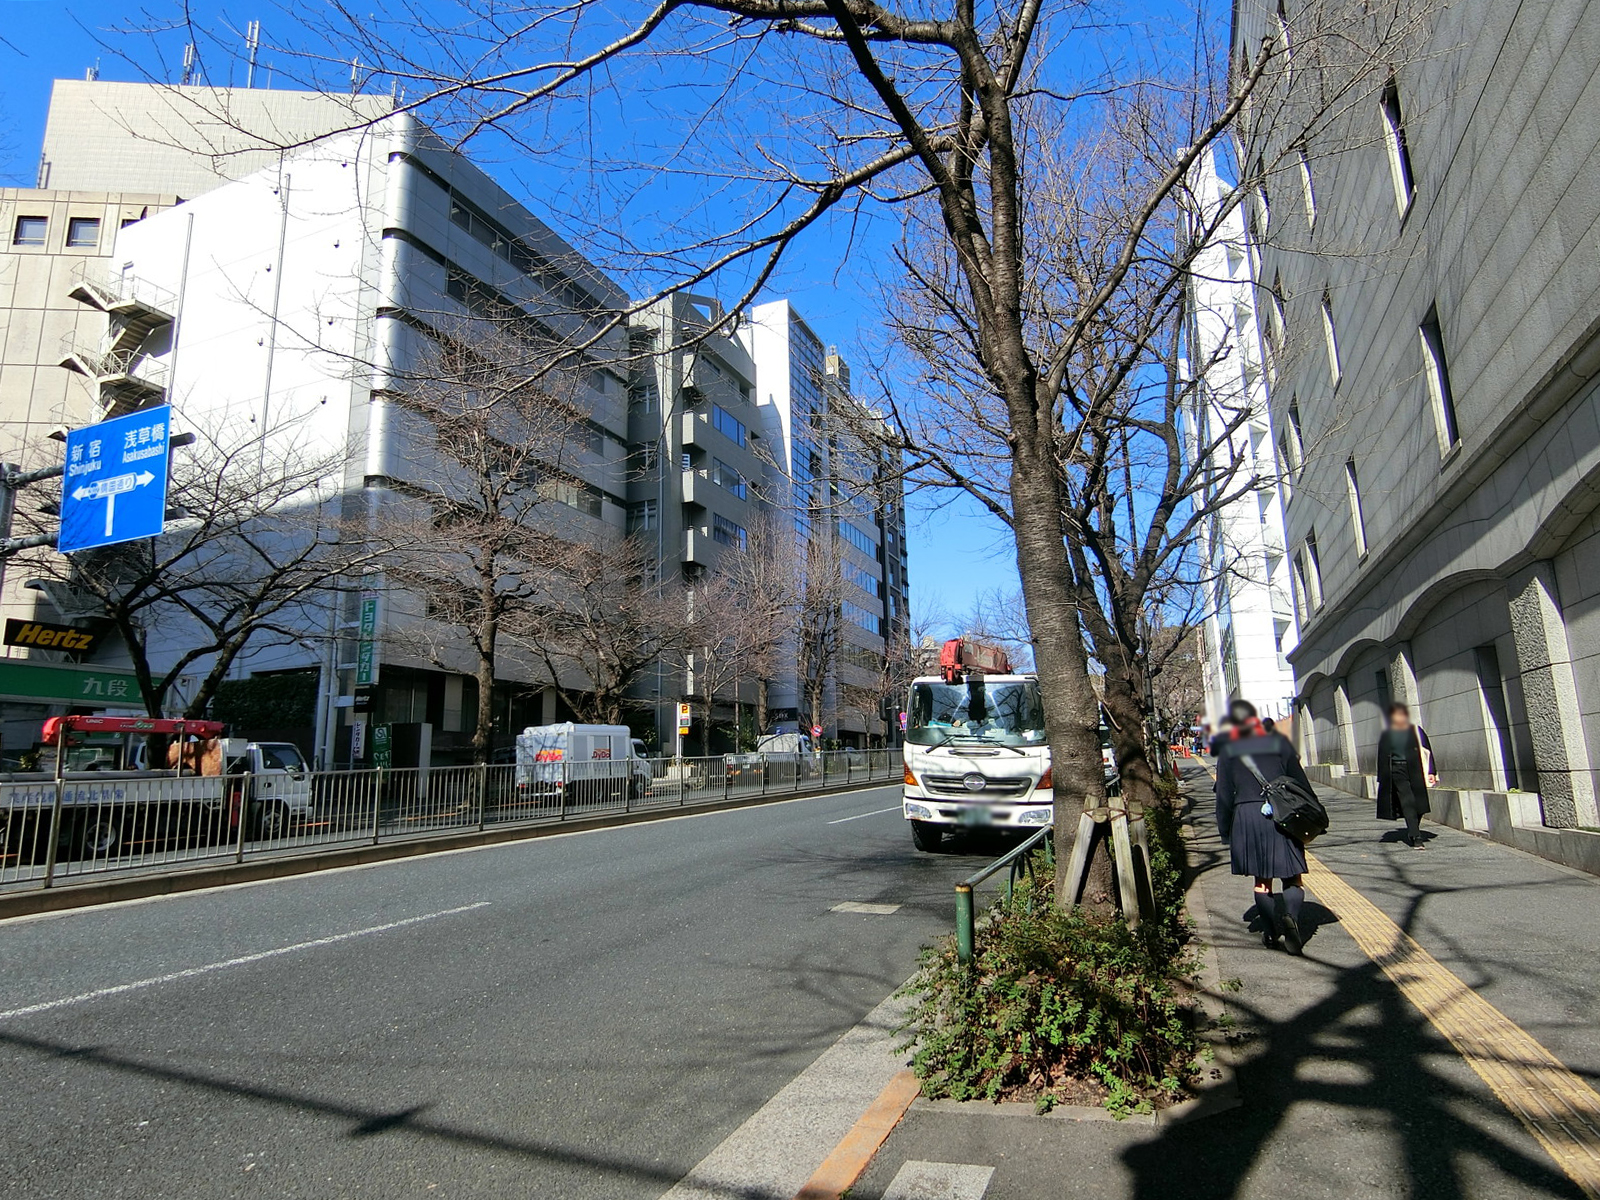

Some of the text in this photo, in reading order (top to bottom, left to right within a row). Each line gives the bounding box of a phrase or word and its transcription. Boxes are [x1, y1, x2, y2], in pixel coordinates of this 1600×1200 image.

[124, 423, 165, 449] 浅草橋
[71, 440, 102, 462] 新宿
[122, 442, 165, 463] Asakusabashi
[69, 460, 102, 477] Shinjuku
[15, 624, 93, 649] Hertz
[535, 750, 563, 763] DyDo
